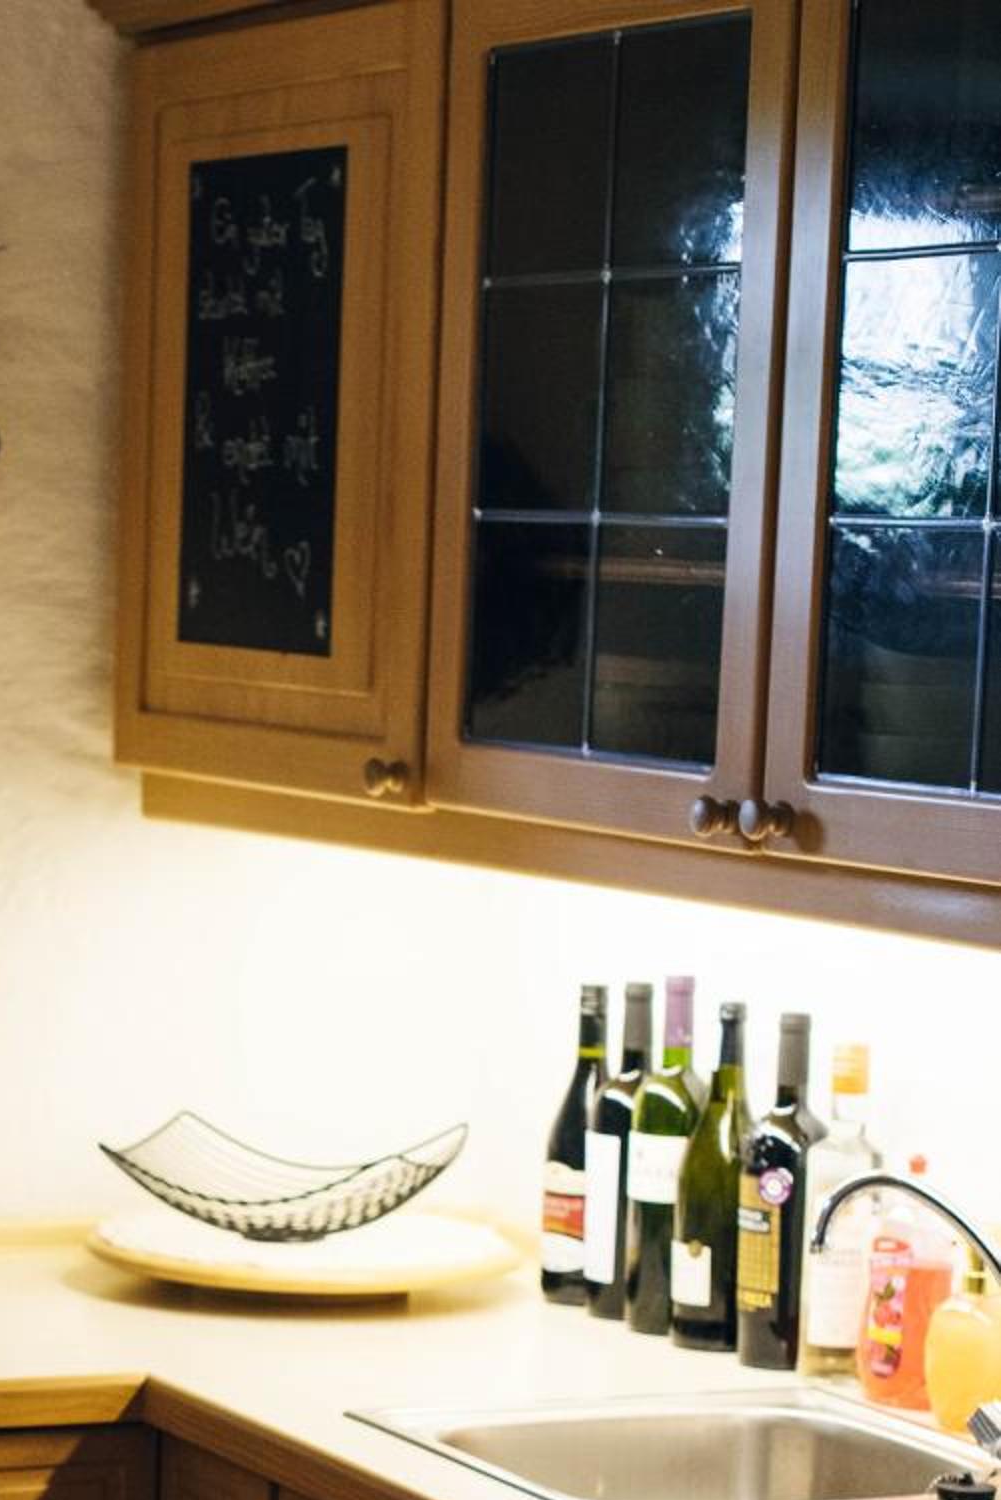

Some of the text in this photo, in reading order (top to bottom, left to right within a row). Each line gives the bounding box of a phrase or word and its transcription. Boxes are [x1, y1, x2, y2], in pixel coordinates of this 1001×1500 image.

[294, 176, 329, 278] Tag
[255, 266, 287, 319] mit
[282, 403, 322, 488] mit
[207, 487, 279, 580] Wein
